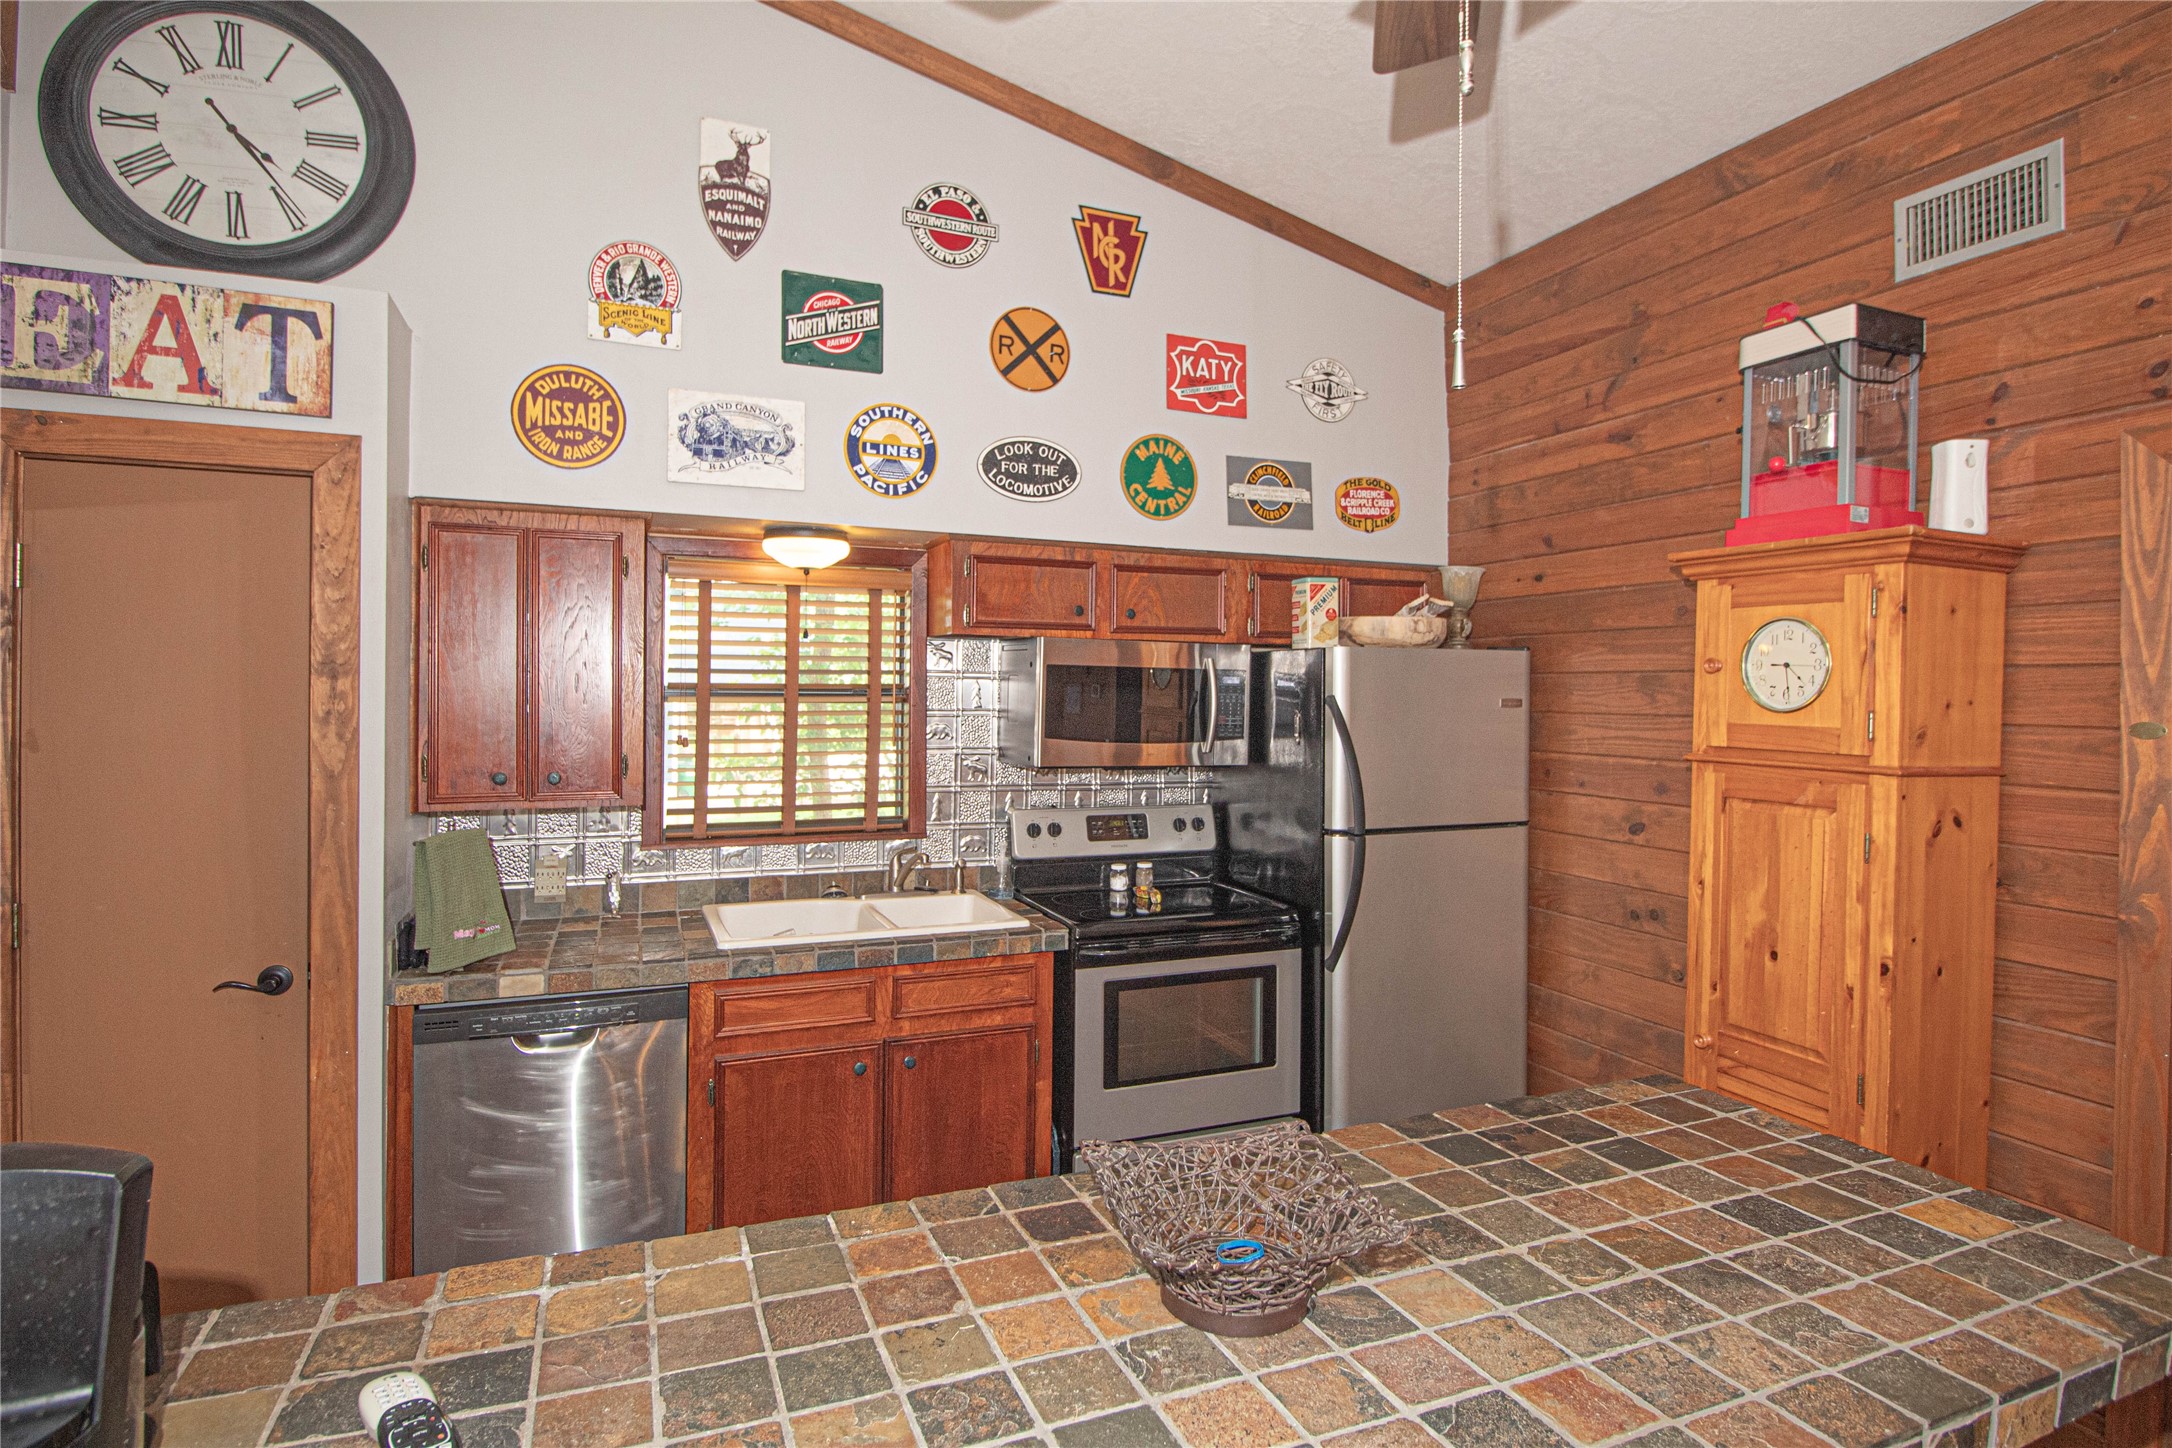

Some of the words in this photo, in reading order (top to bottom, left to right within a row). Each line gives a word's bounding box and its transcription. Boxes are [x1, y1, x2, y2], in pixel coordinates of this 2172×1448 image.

[155, 25, 203, 75] XI
[214, 20, 243, 71] XII
[264, 42, 295, 83] I
[112, 57, 170, 97] X
[292, 84, 343, 112] II
[97, 106, 160, 133] IX
[304, 129, 361, 152] III
[113, 141, 178, 189] VIII
[161, 173, 209, 226] VII
[269, 185, 308, 232] V
[704, 189, 765, 211] ESQUIMALT
[726, 203, 745, 212] AND
[921, 190, 939, 205] EL
[939, 186, 972, 203] PASO
[971, 203, 981, 214] &
[224, 190, 252, 240] VI
[708, 209, 762, 229] NANAIMO
[906, 212, 972, 234] SOUTHWESTERN
[972, 224, 996, 237] ROUTE
[716, 226, 757, 241] RAILWAY
[915, 228, 987, 264] SOUTHWESTERN
[592, 261, 608, 294] DENVER
[601, 251, 612, 262] &
[608, 244, 626, 258] RIO
[626, 243, 663, 264] GRANDE
[660, 257, 678, 304] WESTERN
[813, 297, 841, 309] CHICAGO
[0, 274, 323, 405] EAT
[826, 336, 854, 348] RAILWAY
[1181, 354, 1232, 382] KATY
[1312, 361, 1348, 378] SAFETY
[534, 373, 604, 400] DULUTH
[525, 391, 614, 438] MISSABE
[694, 402, 733, 415] GRAND
[735, 402, 779, 423] CANYON
[1312, 402, 1343, 419] FIRST
[555, 429, 583, 440] AND
[850, 406, 934, 445] SOUTHERN
[528, 428, 560, 456] IRON
[563, 435, 607, 460] RANGE
[866, 442, 920, 458] LINES
[994, 443, 1033, 460] LOOK
[1038, 446, 1067, 465] OUT
[1134, 439, 1186, 465] MAINE
[709, 454, 767, 470] RAILWAY
[1001, 461, 1028, 474] FOR
[1032, 464, 1059, 477] THE
[853, 463, 929, 496] PACIFIC
[988, 467, 1073, 496] LOCOMOTIVE
[1249, 465, 1290, 486] CLINCHFIELD
[1343, 478, 1364, 490] THE
[1365, 478, 1392, 492] GOLD
[1129, 483, 1192, 515] CENTRAL
[1349, 489, 1385, 498] FLORENCE
[1373, 498, 1395, 507] CREEK
[1253, 503, 1289, 520] RAILROAD
[1340, 512, 1362, 528] BELT
[1375, 513, 1396, 528] LINE
[1347, 506, 1379, 515] RAILROAD
[1310, 584, 1338, 616] PREMIUM
[1783, 629, 1794, 641] 12
[1809, 642, 1817, 654] 2
[1813, 658, 1822, 671] 3
[1808, 674, 1815, 687] 4
